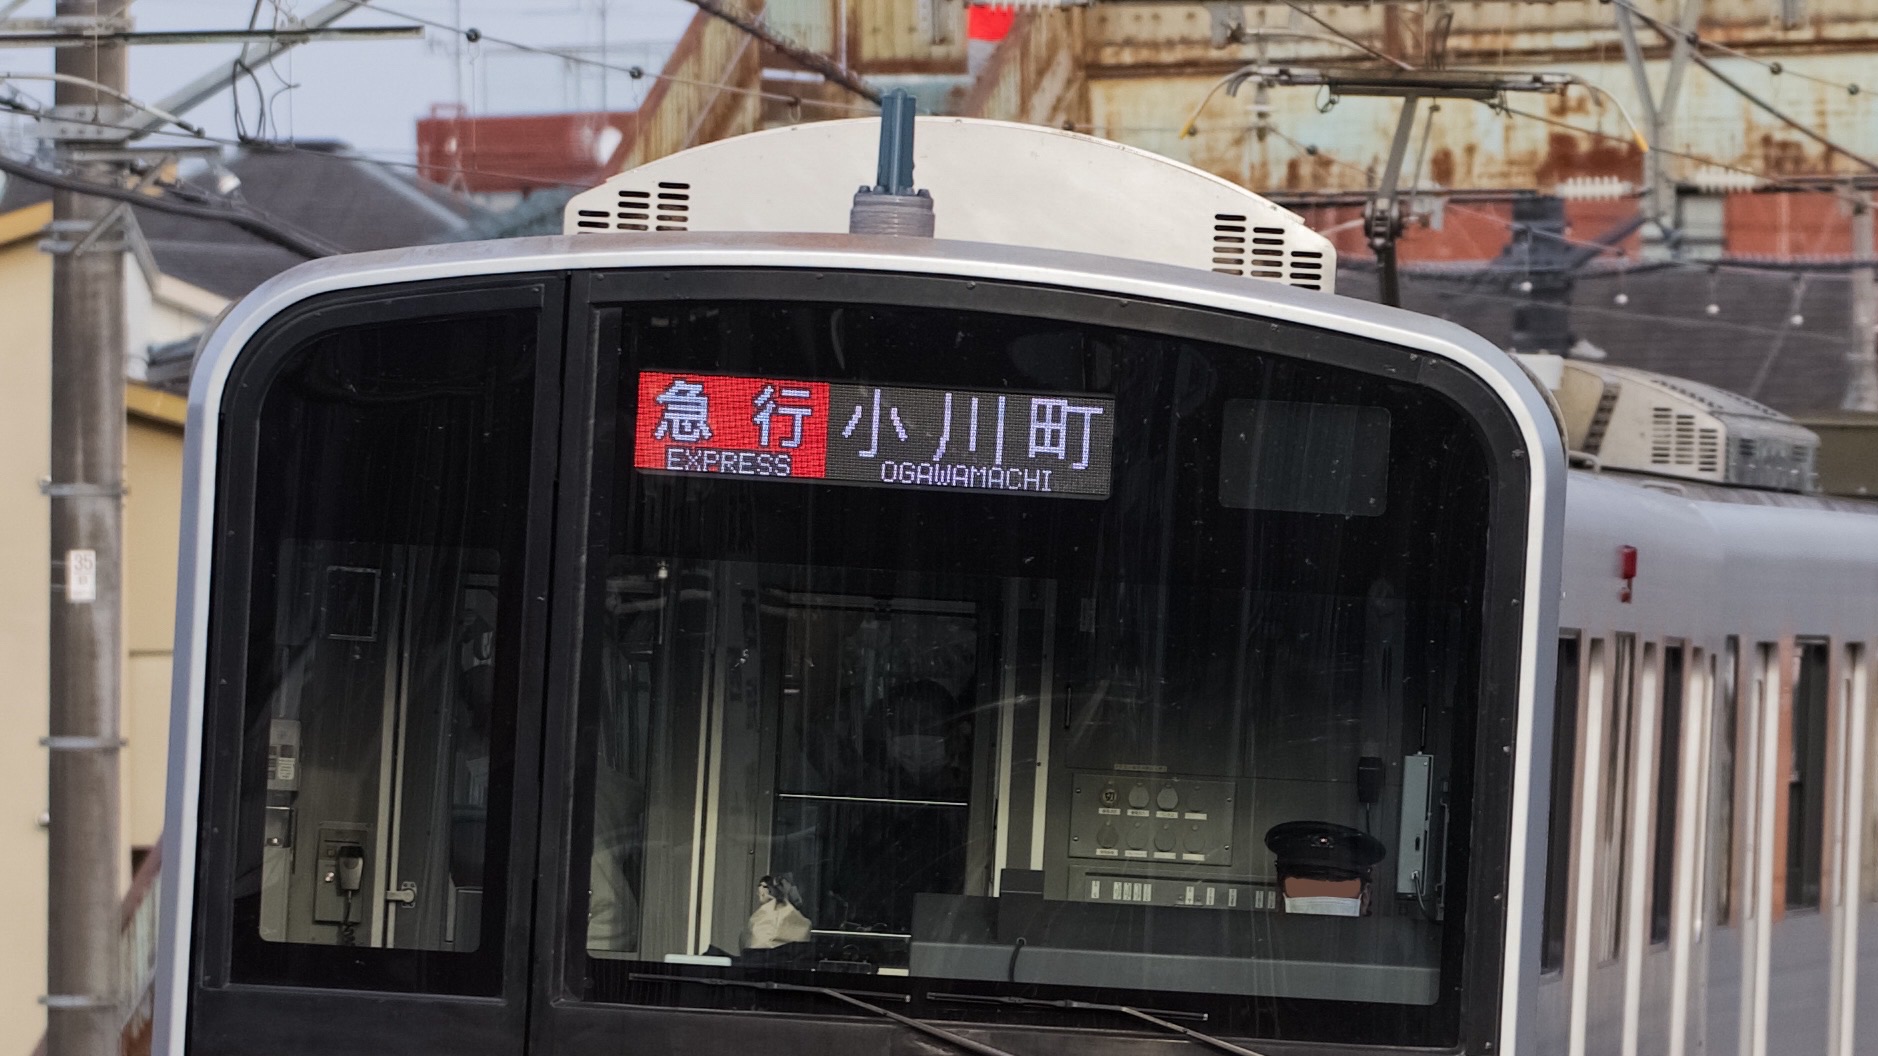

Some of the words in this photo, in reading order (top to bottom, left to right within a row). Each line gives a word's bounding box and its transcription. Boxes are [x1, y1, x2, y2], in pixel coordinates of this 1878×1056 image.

[653, 379, 813, 448] 急行
[841, 387, 1104, 470] 小川町
[666, 447, 792, 477] EXPRESS
[880, 460, 1053, 492] OGAWAMACHI
